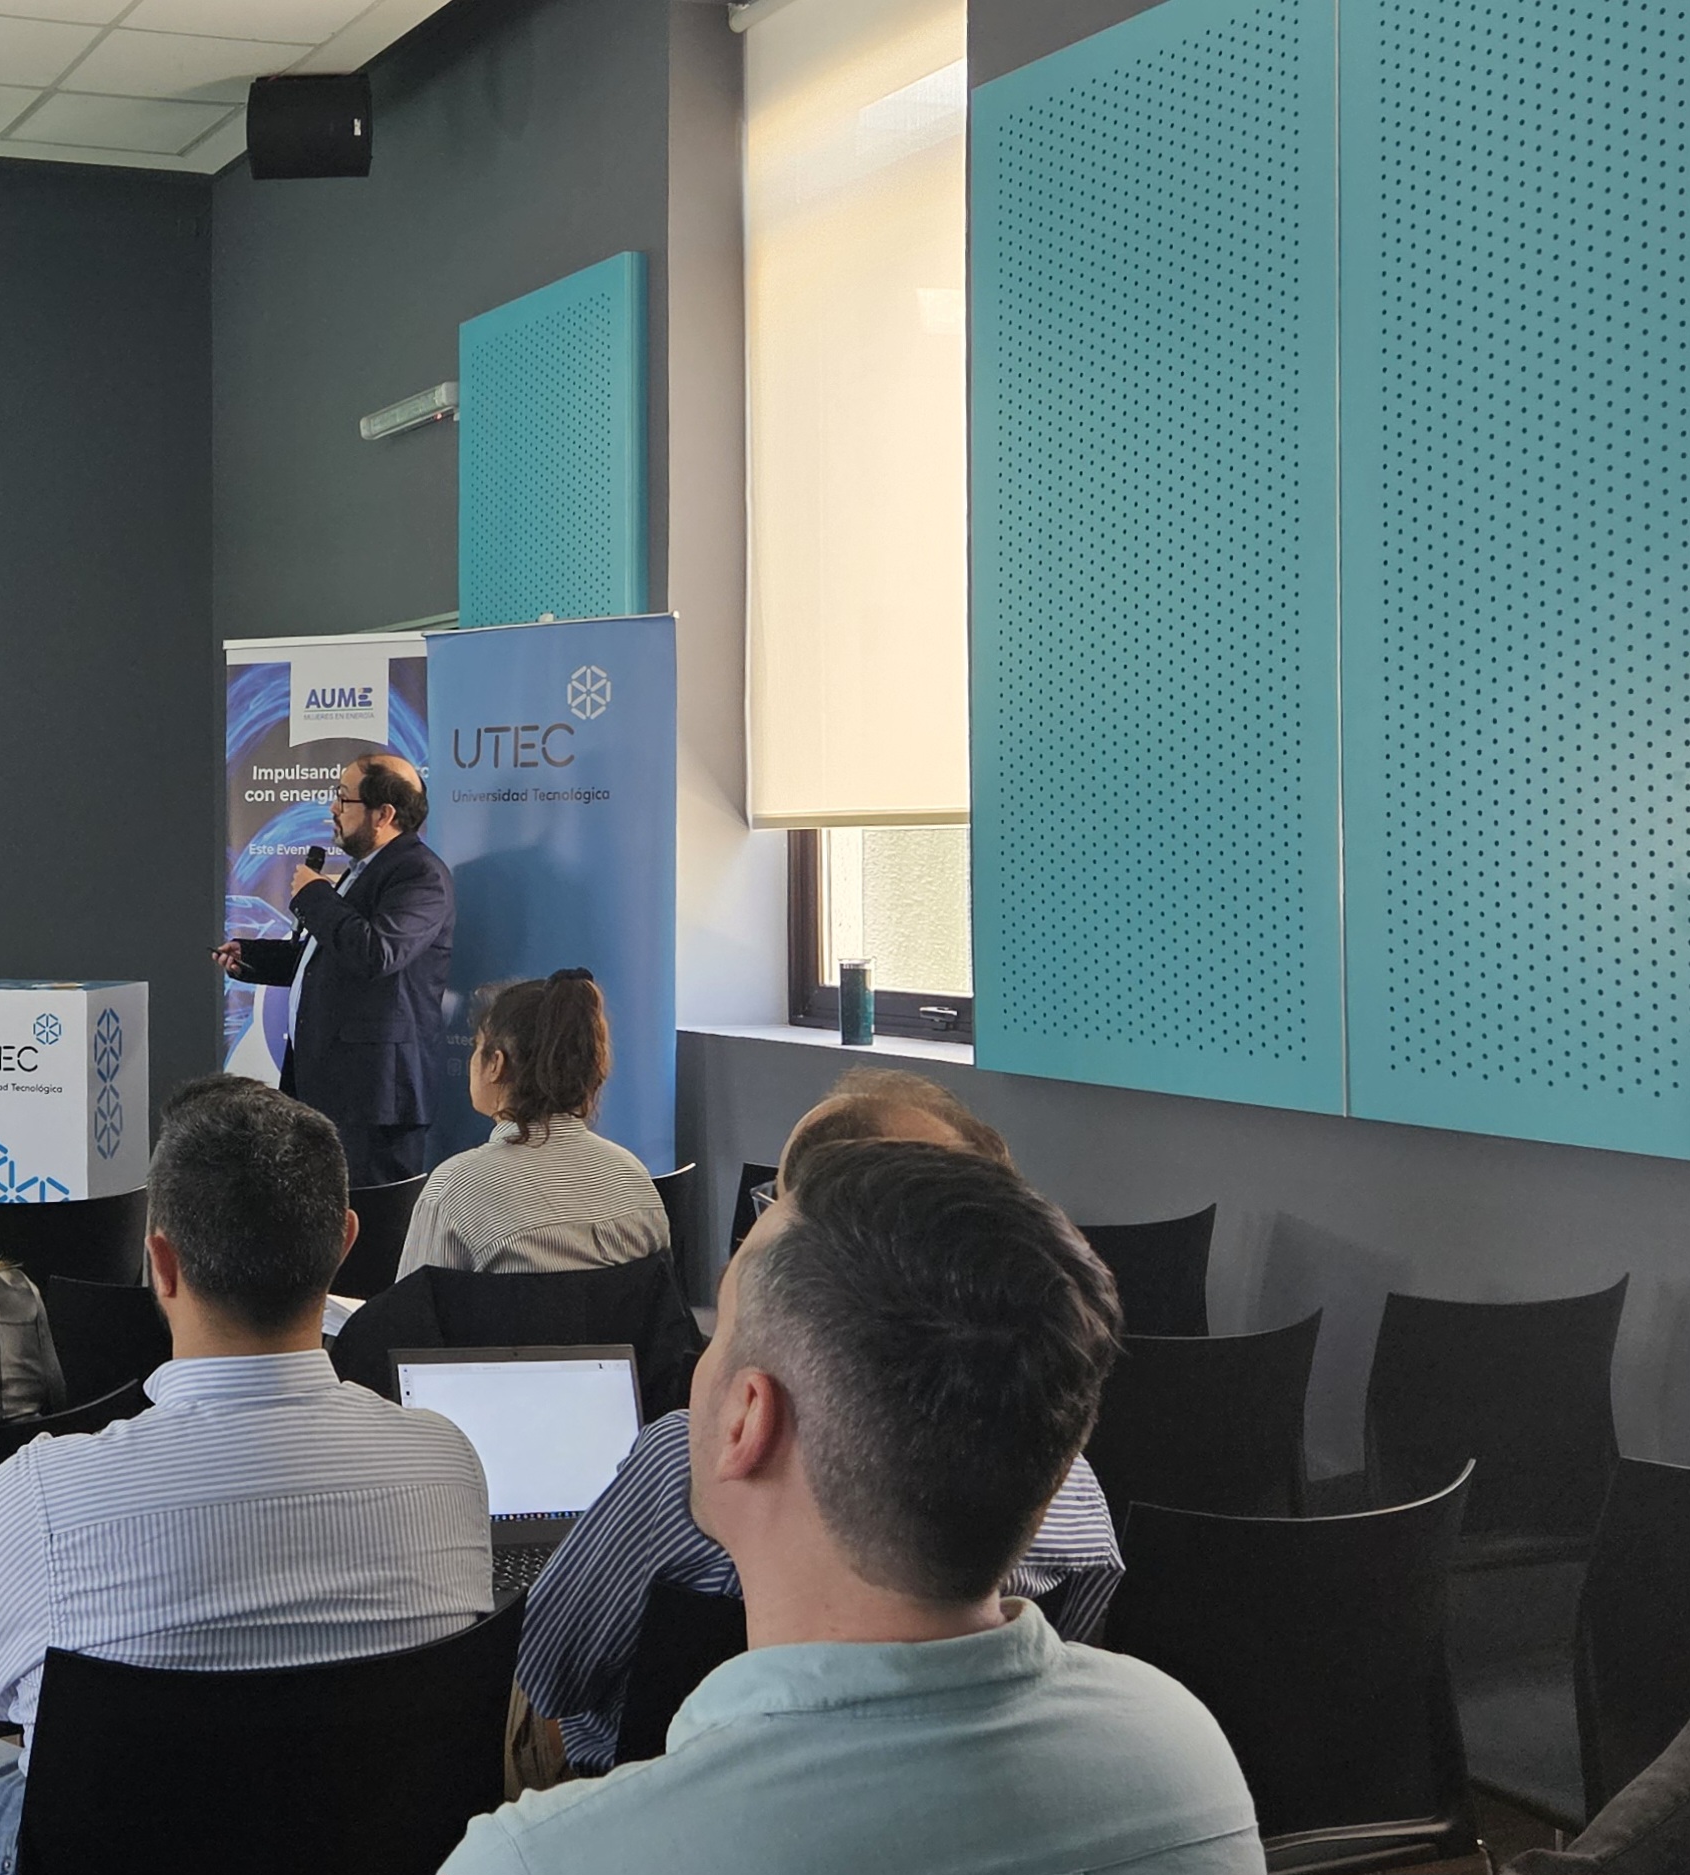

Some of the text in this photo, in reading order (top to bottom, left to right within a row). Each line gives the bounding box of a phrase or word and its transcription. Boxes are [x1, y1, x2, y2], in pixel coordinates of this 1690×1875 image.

[305, 687, 373, 709] AUME
[453, 723, 575, 769] UTEC
[245, 790, 274, 802] con
[452, 787, 610, 804] Universidad Tecnológica
[249, 844, 310, 855] Este Event
[11, 1083, 63, 1094] Tecnológica
